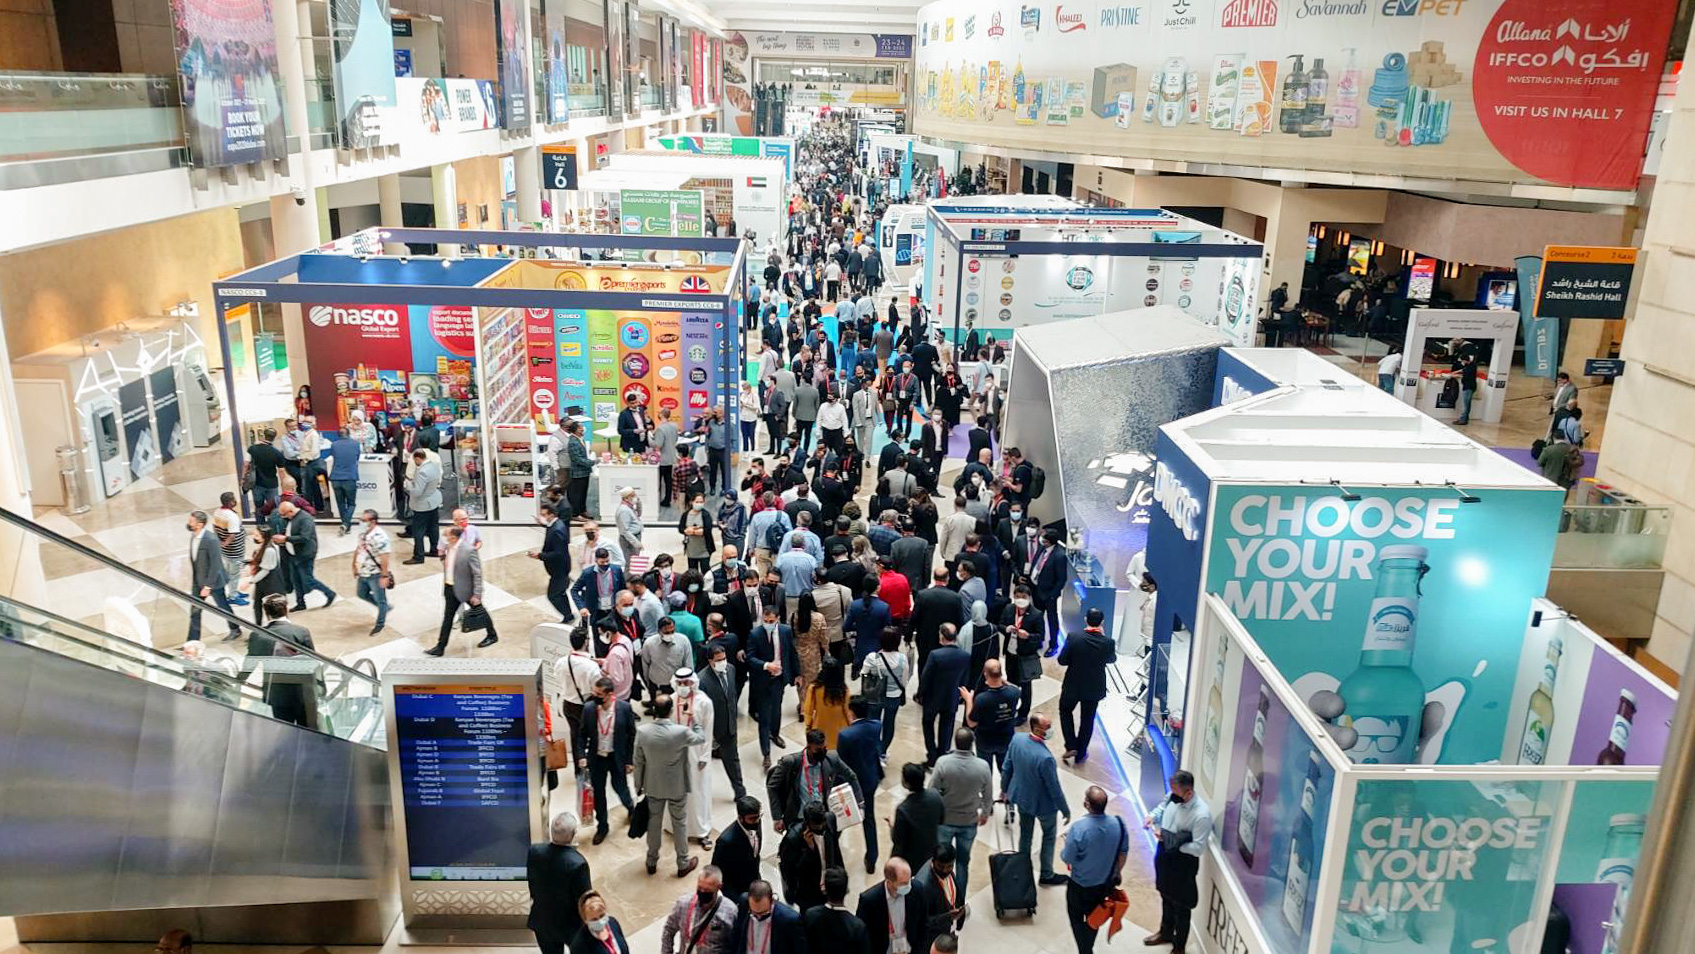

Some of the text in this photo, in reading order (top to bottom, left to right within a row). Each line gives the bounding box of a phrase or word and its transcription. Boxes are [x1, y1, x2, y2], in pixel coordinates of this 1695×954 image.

[1101, 7, 1139, 29] PRISTINE
[1222, 0, 1277, 28] PREMIER
[1296, 0, 1367, 19] Savannah
[1489, 53, 1547, 67] IFFCO
[1507, 75, 1621, 86] INVESTING IN THE FUTURE
[227, 112, 246, 124] BOOK
[1494, 105, 1624, 120] VISIT US IN HALL 7
[226, 126, 251, 139] TICKETS
[555, 168, 567, 188] 6
[1545, 291, 1622, 301] Sheikh Rashid Hall
[333, 309, 399, 327] nasco
[690, 392, 707, 407] illy
[1230, 495, 1456, 539] CHOOSE
[1226, 538, 1376, 585] YOUR
[1225, 581, 1336, 622] MIX!
[1361, 816, 1542, 849] CHOOSE
[1356, 849, 1477, 882] YOUR
[1347, 881, 1446, 913] MIX!
